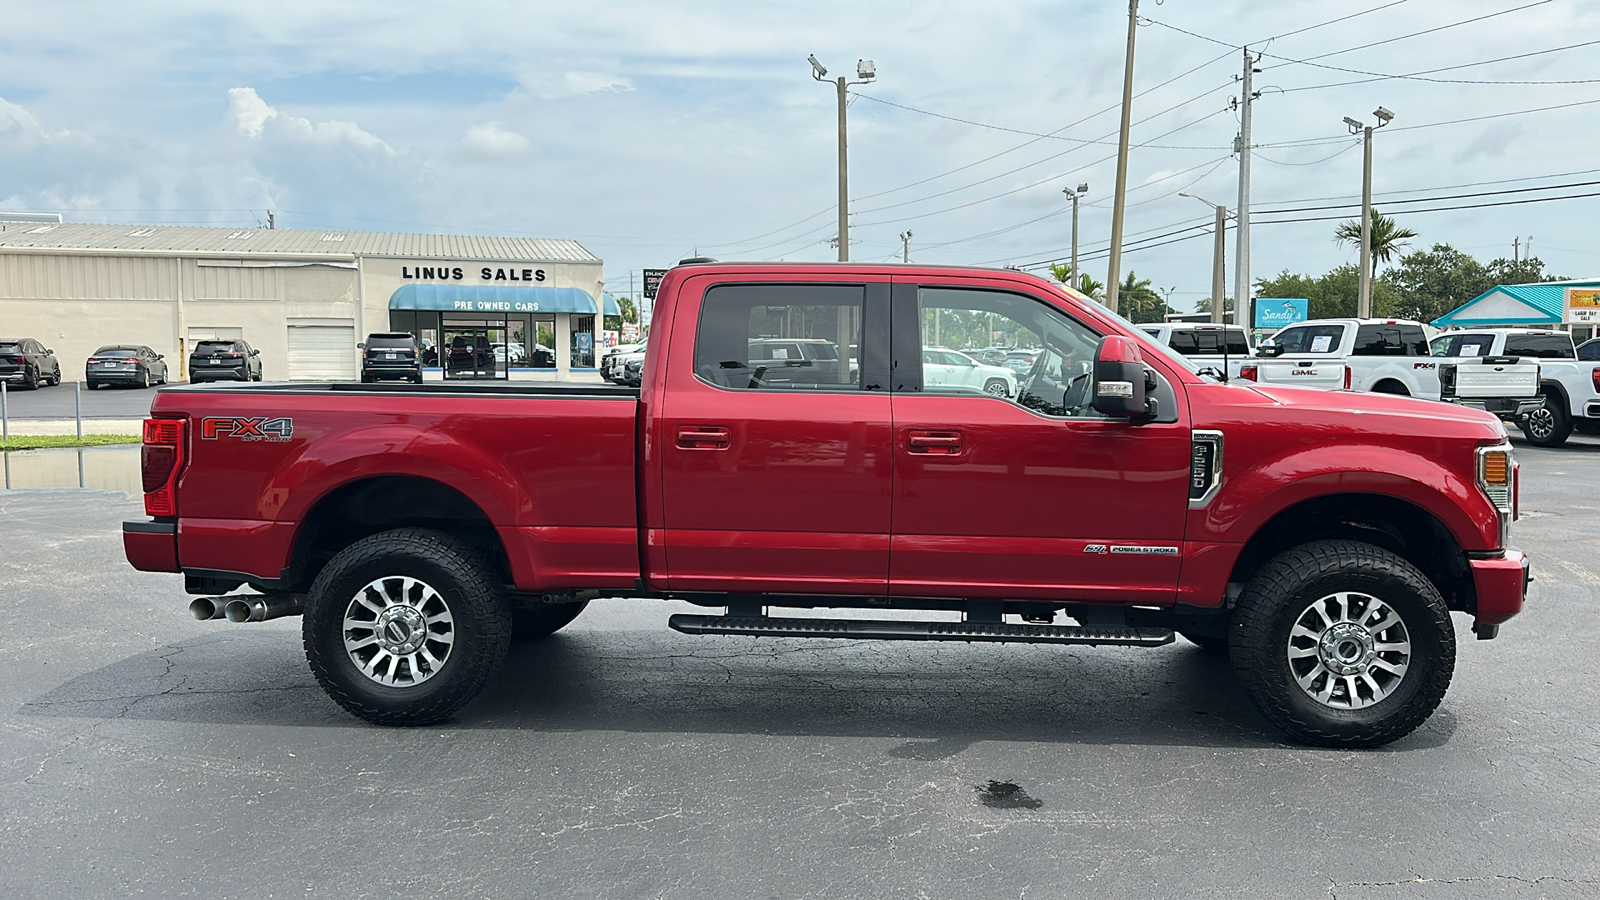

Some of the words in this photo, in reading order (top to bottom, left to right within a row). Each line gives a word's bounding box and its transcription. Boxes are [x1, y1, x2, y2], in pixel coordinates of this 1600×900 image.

[402, 266, 464, 280] LINUS
[481, 267, 546, 282] SALES
[454, 300, 473, 310] PRE
[477, 301, 511, 310] OWNED
[515, 302, 539, 311] CARS
[202, 416, 293, 439] FX4
